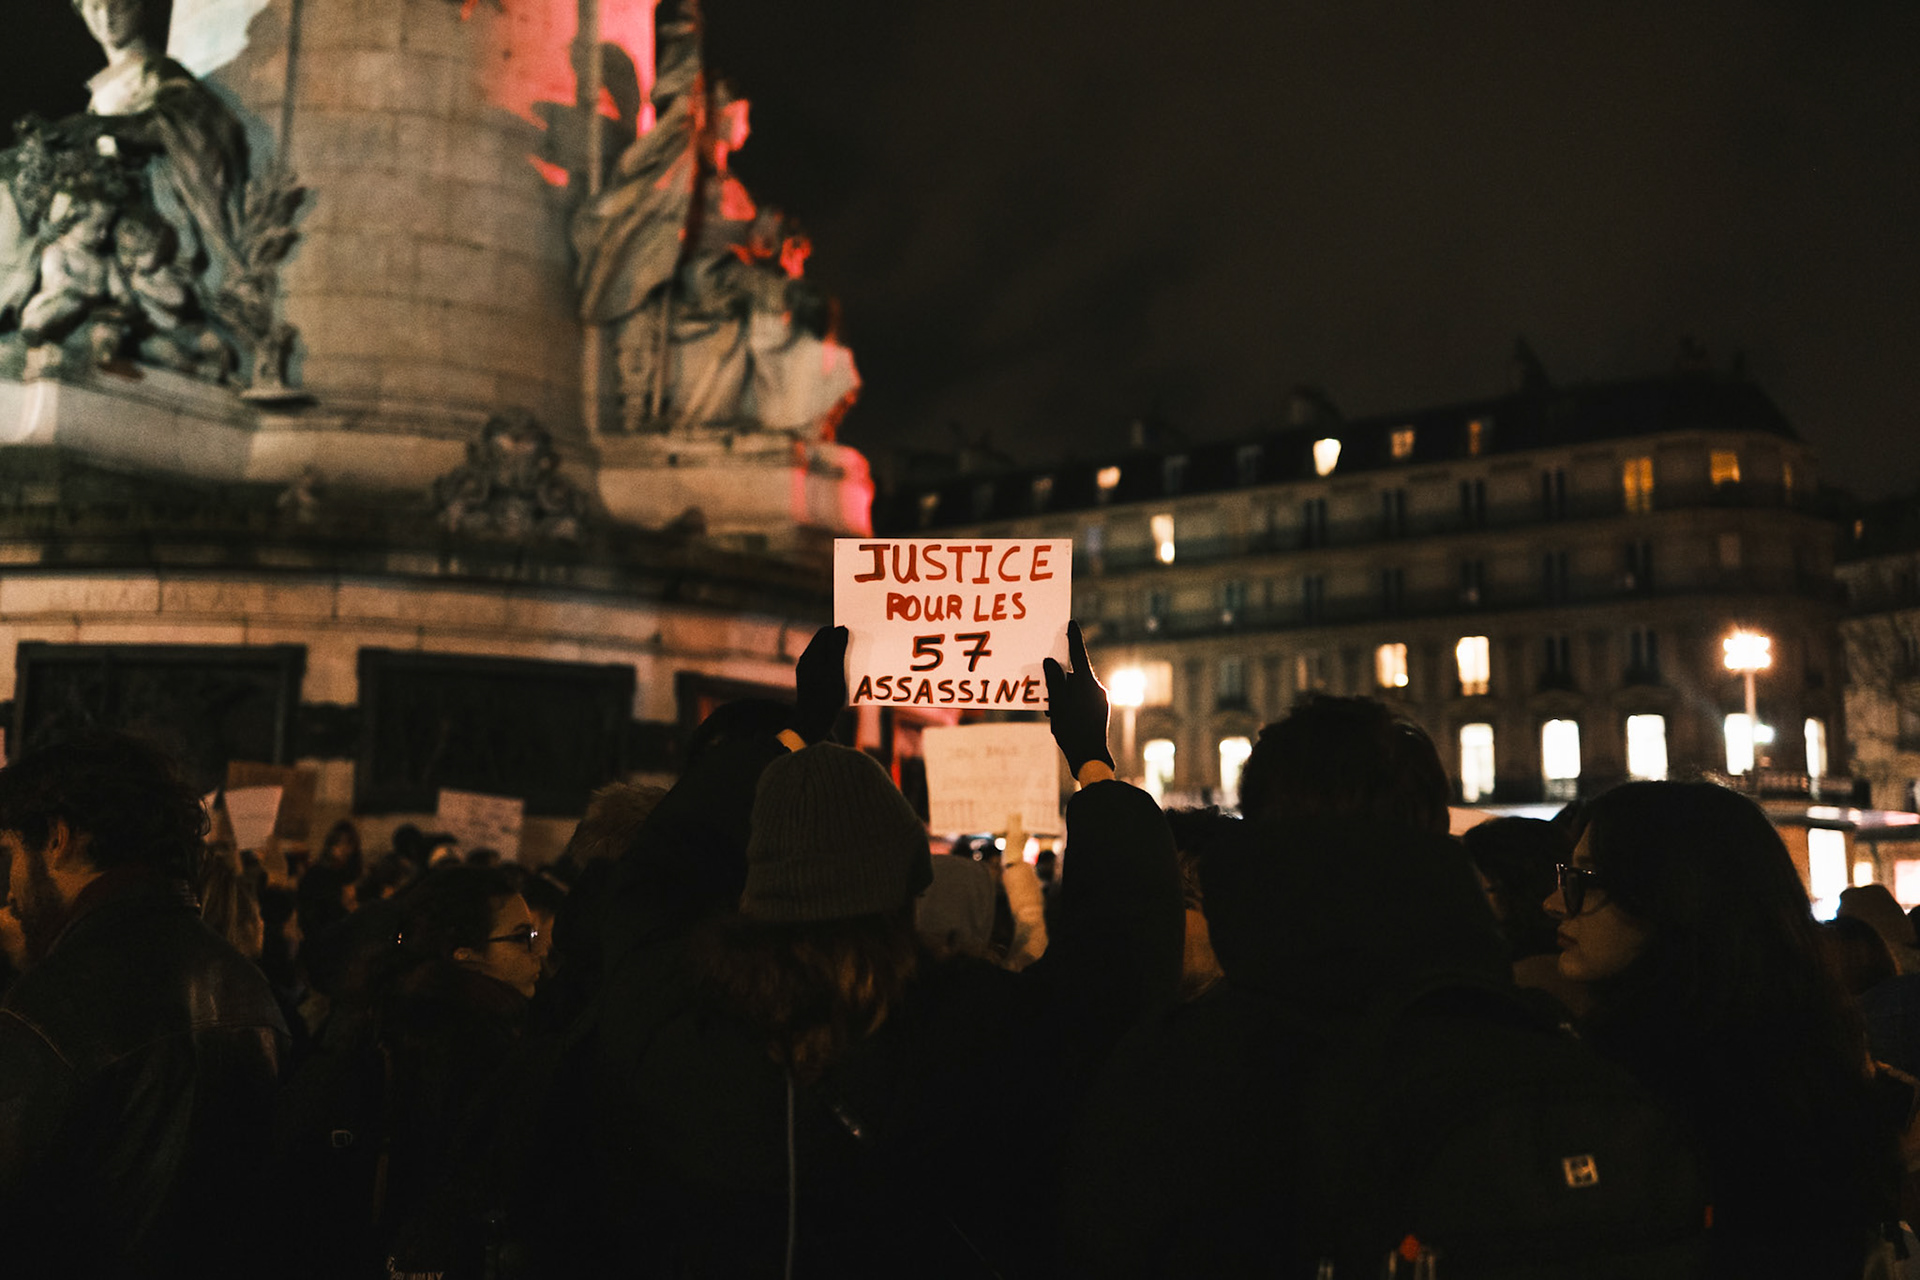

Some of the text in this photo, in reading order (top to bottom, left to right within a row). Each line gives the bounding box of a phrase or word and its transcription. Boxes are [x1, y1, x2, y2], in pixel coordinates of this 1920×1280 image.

[854, 544, 1054, 584] JUSTICE
[886, 592, 1027, 622] POUR LES
[910, 631, 992, 672] 57
[853, 675, 1050, 705] ASSASSINÉ
